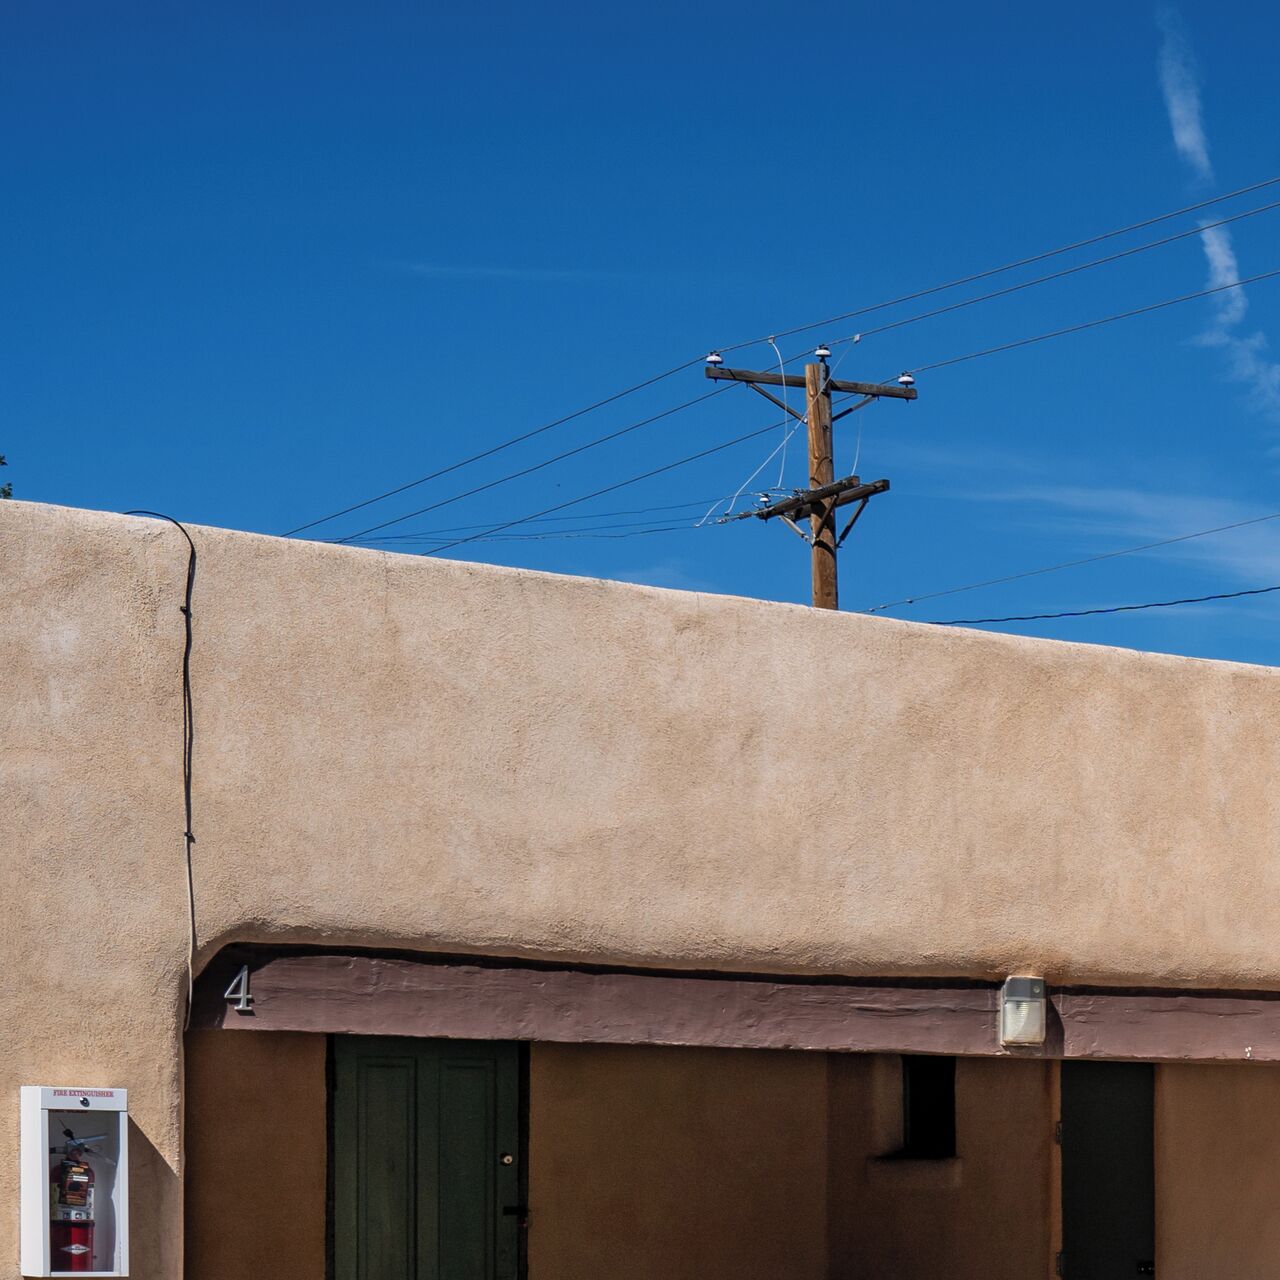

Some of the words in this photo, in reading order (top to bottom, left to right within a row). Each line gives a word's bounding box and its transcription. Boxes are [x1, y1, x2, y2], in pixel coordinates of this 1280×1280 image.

[224, 965, 252, 1010] 4
[53, 1089, 67, 1097] FIRE
[68, 1090, 114, 1098] EXTINGUISHER
